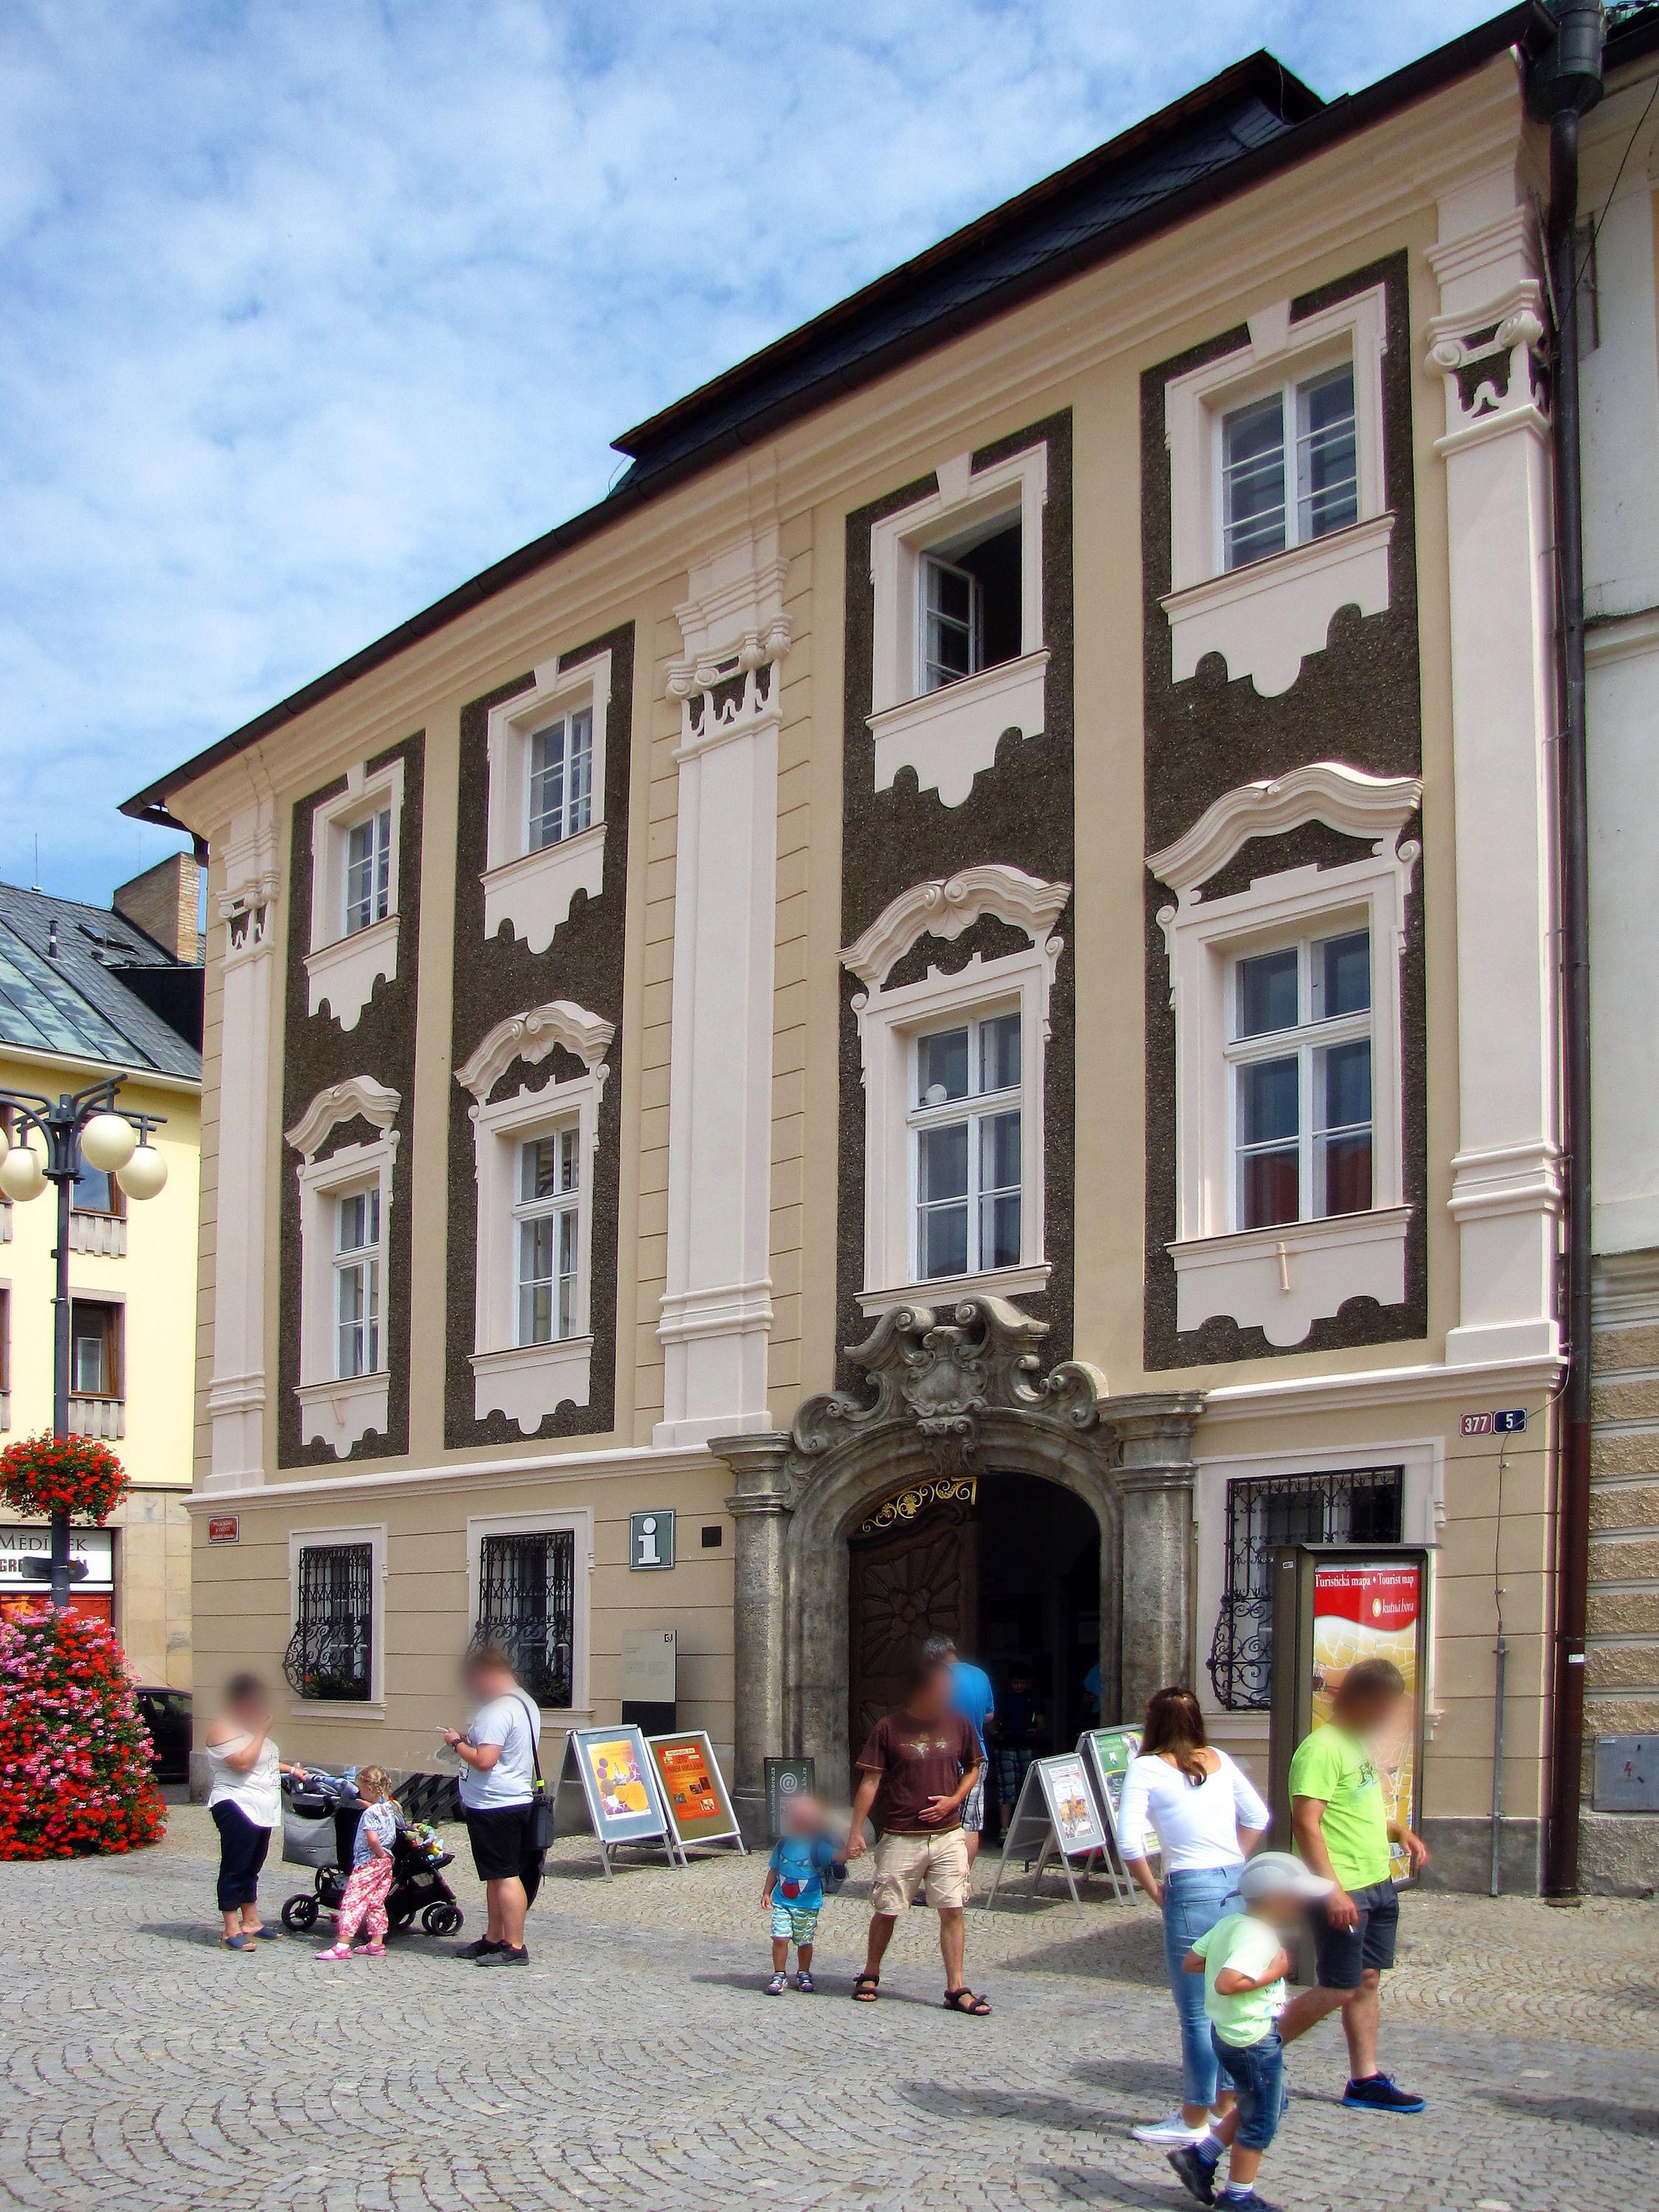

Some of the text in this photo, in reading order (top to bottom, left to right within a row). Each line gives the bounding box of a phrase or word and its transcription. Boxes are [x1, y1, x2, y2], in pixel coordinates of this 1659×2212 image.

[1464, 1416, 1487, 1433] 377
[1506, 1413, 1514, 1429] 5
[0, 1534, 88, 1551] MĚDÍEK
[1315, 1572, 1414, 1590] Turistická mapa Tourist map
